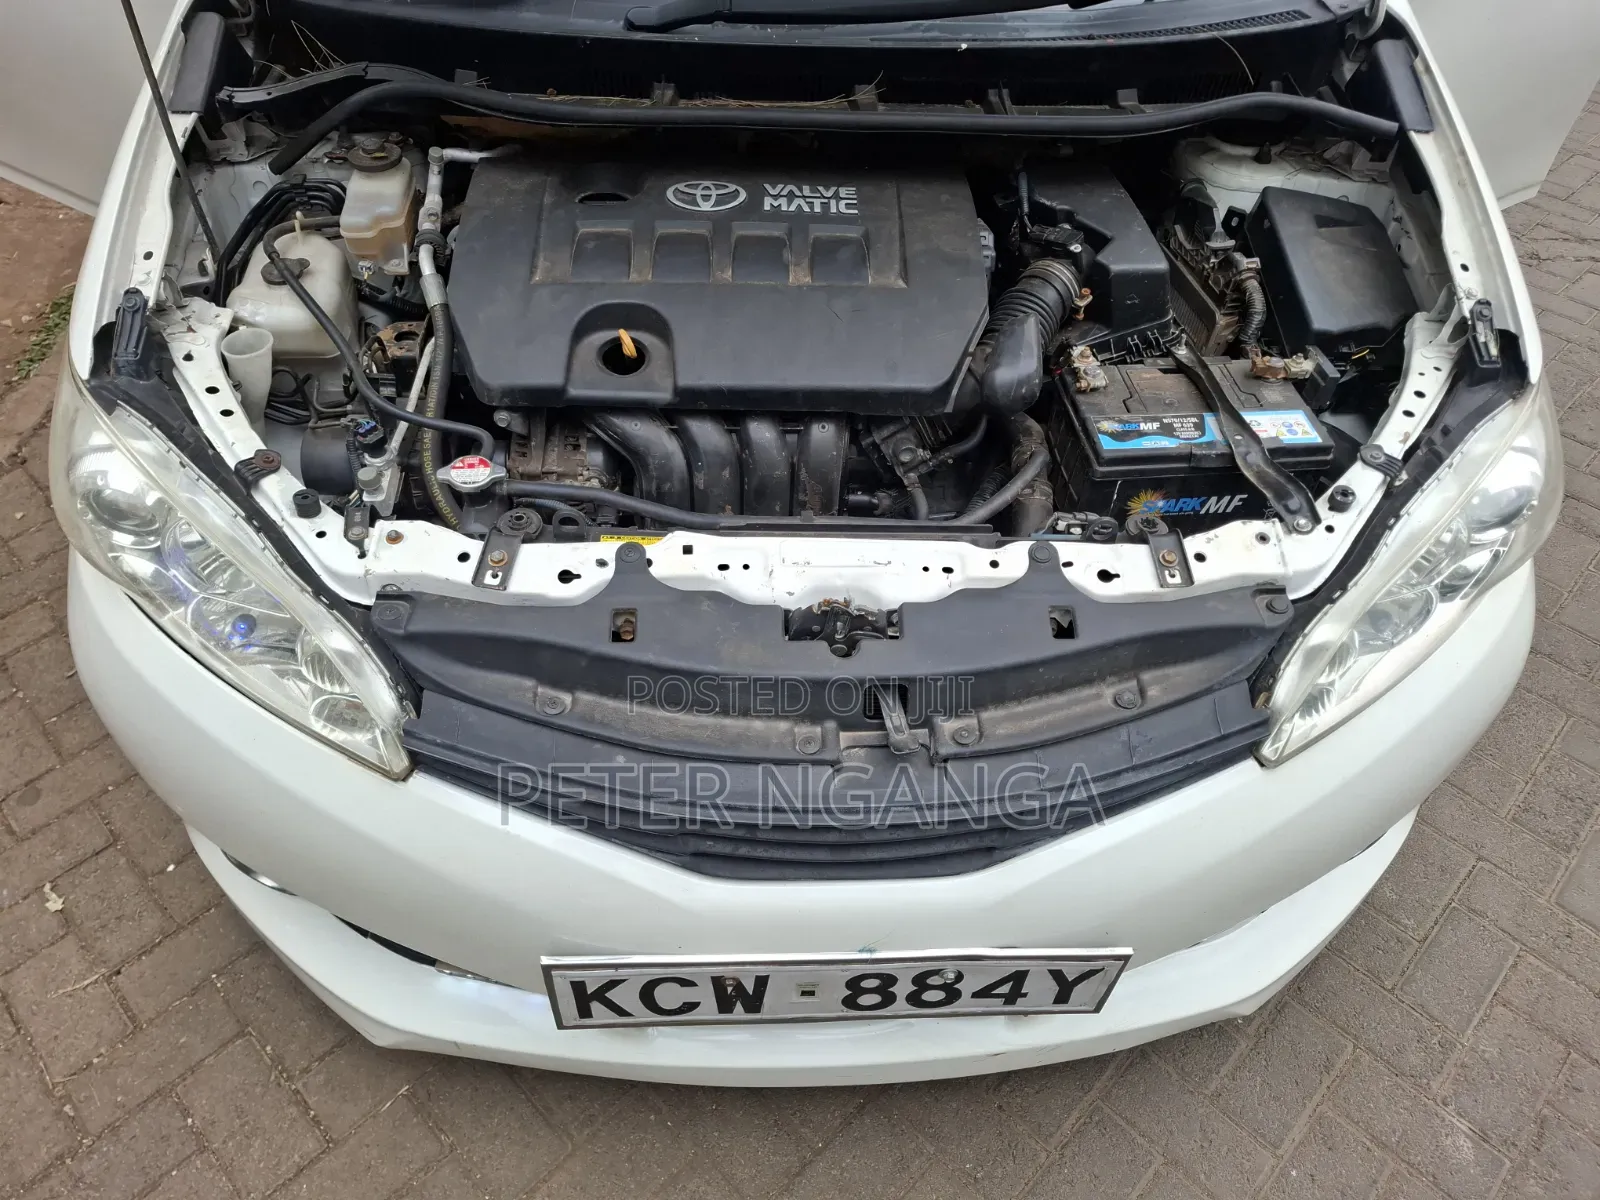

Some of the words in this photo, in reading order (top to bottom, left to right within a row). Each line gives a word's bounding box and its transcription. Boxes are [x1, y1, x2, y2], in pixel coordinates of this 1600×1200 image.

[763, 183, 857, 198] VALVE
[763, 197, 859, 214] MATIC
[423, 449, 434, 475] HOSE
[428, 475, 458, 524] HYDRAULIC
[569, 974, 771, 1020] KCW
[841, 968, 1106, 1012] 884Y
